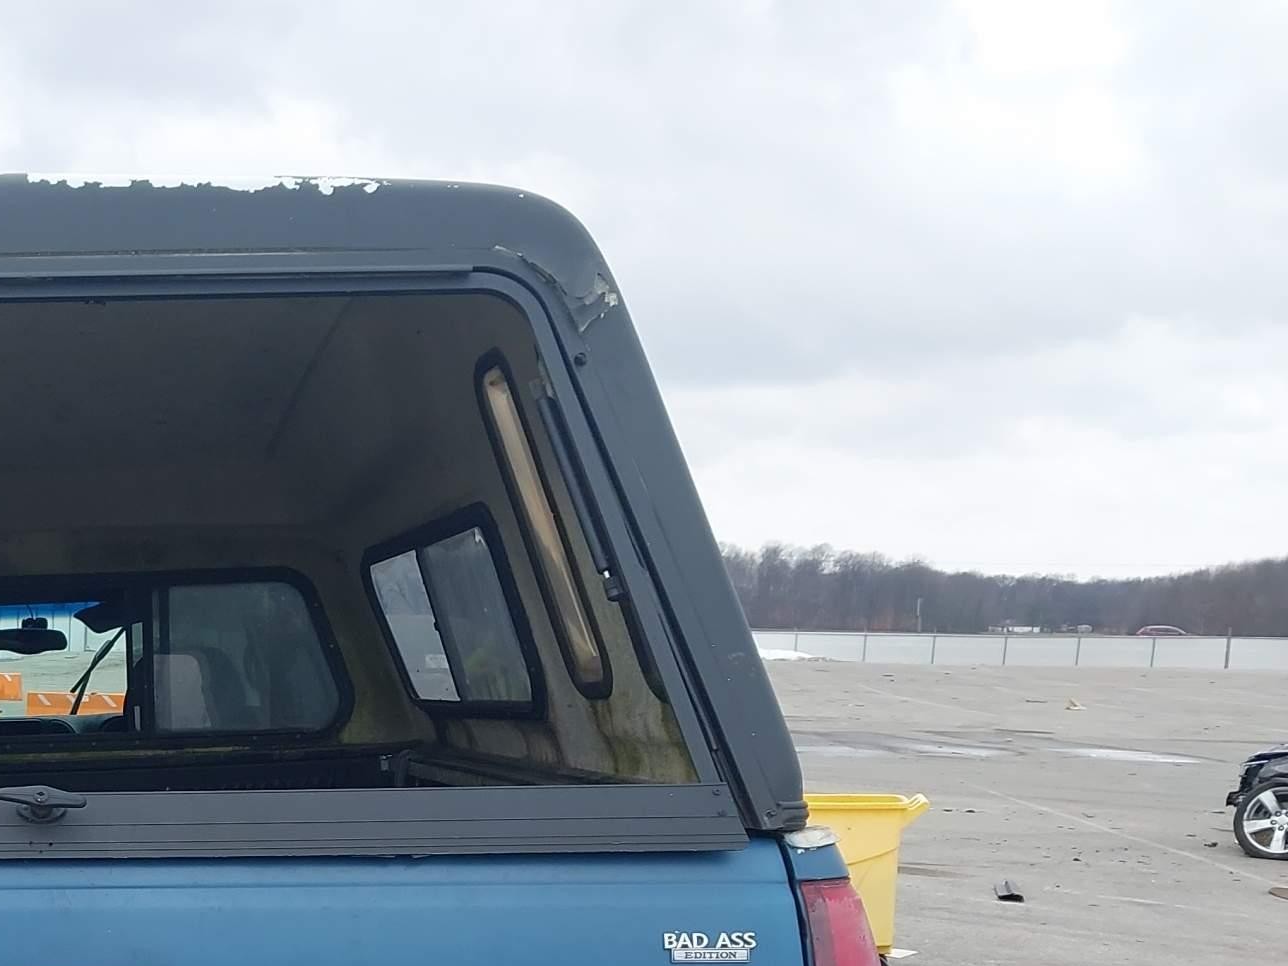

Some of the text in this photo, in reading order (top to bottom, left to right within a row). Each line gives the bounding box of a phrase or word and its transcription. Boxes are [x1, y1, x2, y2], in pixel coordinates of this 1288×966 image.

[664, 931, 757, 949] BAD ASS
[684, 951, 738, 960] EDITION
